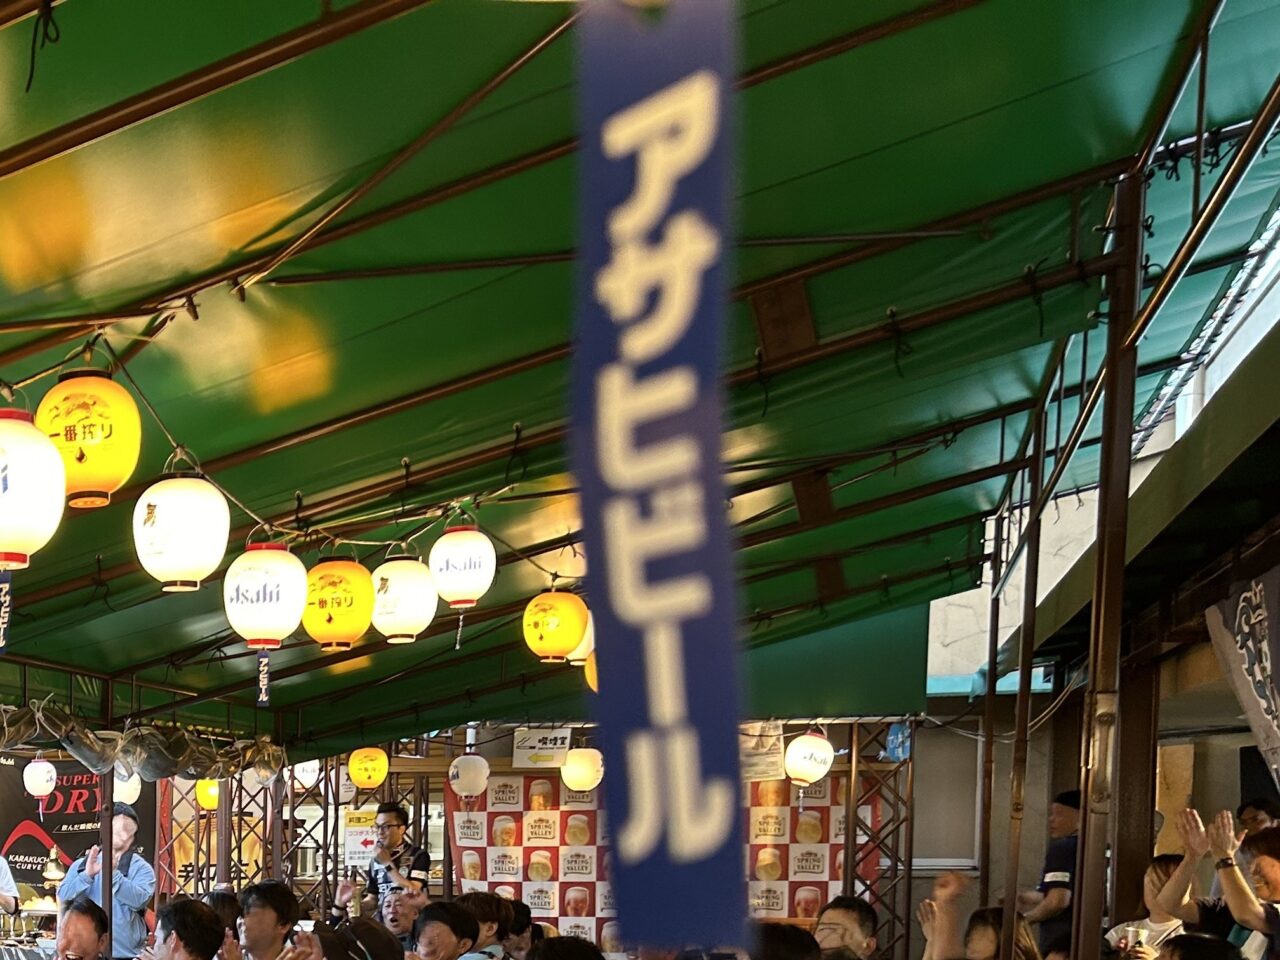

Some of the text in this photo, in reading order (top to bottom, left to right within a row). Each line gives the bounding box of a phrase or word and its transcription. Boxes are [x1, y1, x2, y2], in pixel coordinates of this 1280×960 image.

[49, 423, 113, 442] 一番搾り
[595, 70, 734, 867] アサヒビール
[229, 582, 281, 605] Asahi
[258, 658, 269, 702] アサヒビール
[8, 854, 50, 863] KARAKUCH
[15, 863, 42, 871] CURVE
